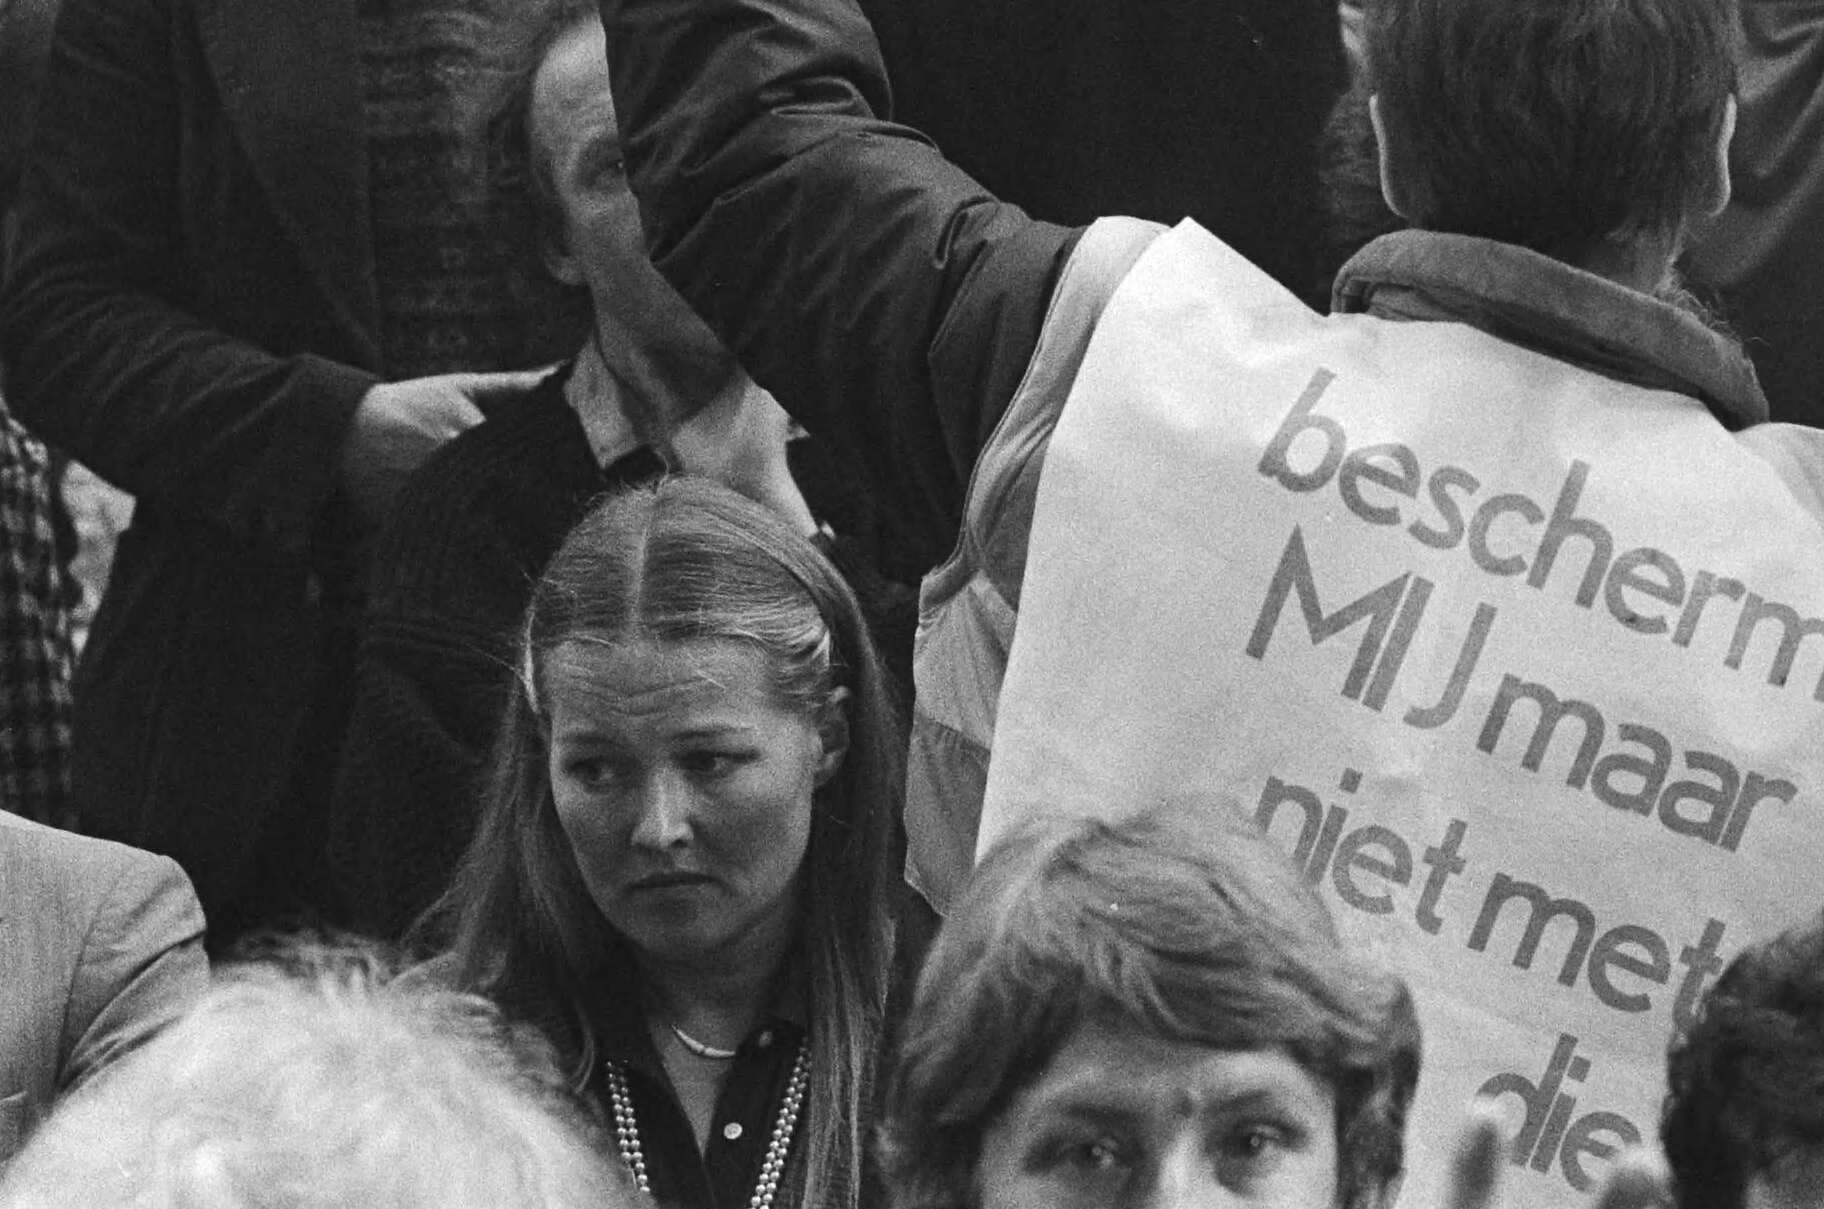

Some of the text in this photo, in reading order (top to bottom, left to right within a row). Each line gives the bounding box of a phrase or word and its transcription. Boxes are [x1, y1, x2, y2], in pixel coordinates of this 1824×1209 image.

[1245, 524, 1798, 852] MIJ maar
[1254, 761, 1726, 1036] niet met
[1475, 1033, 1642, 1192] die
